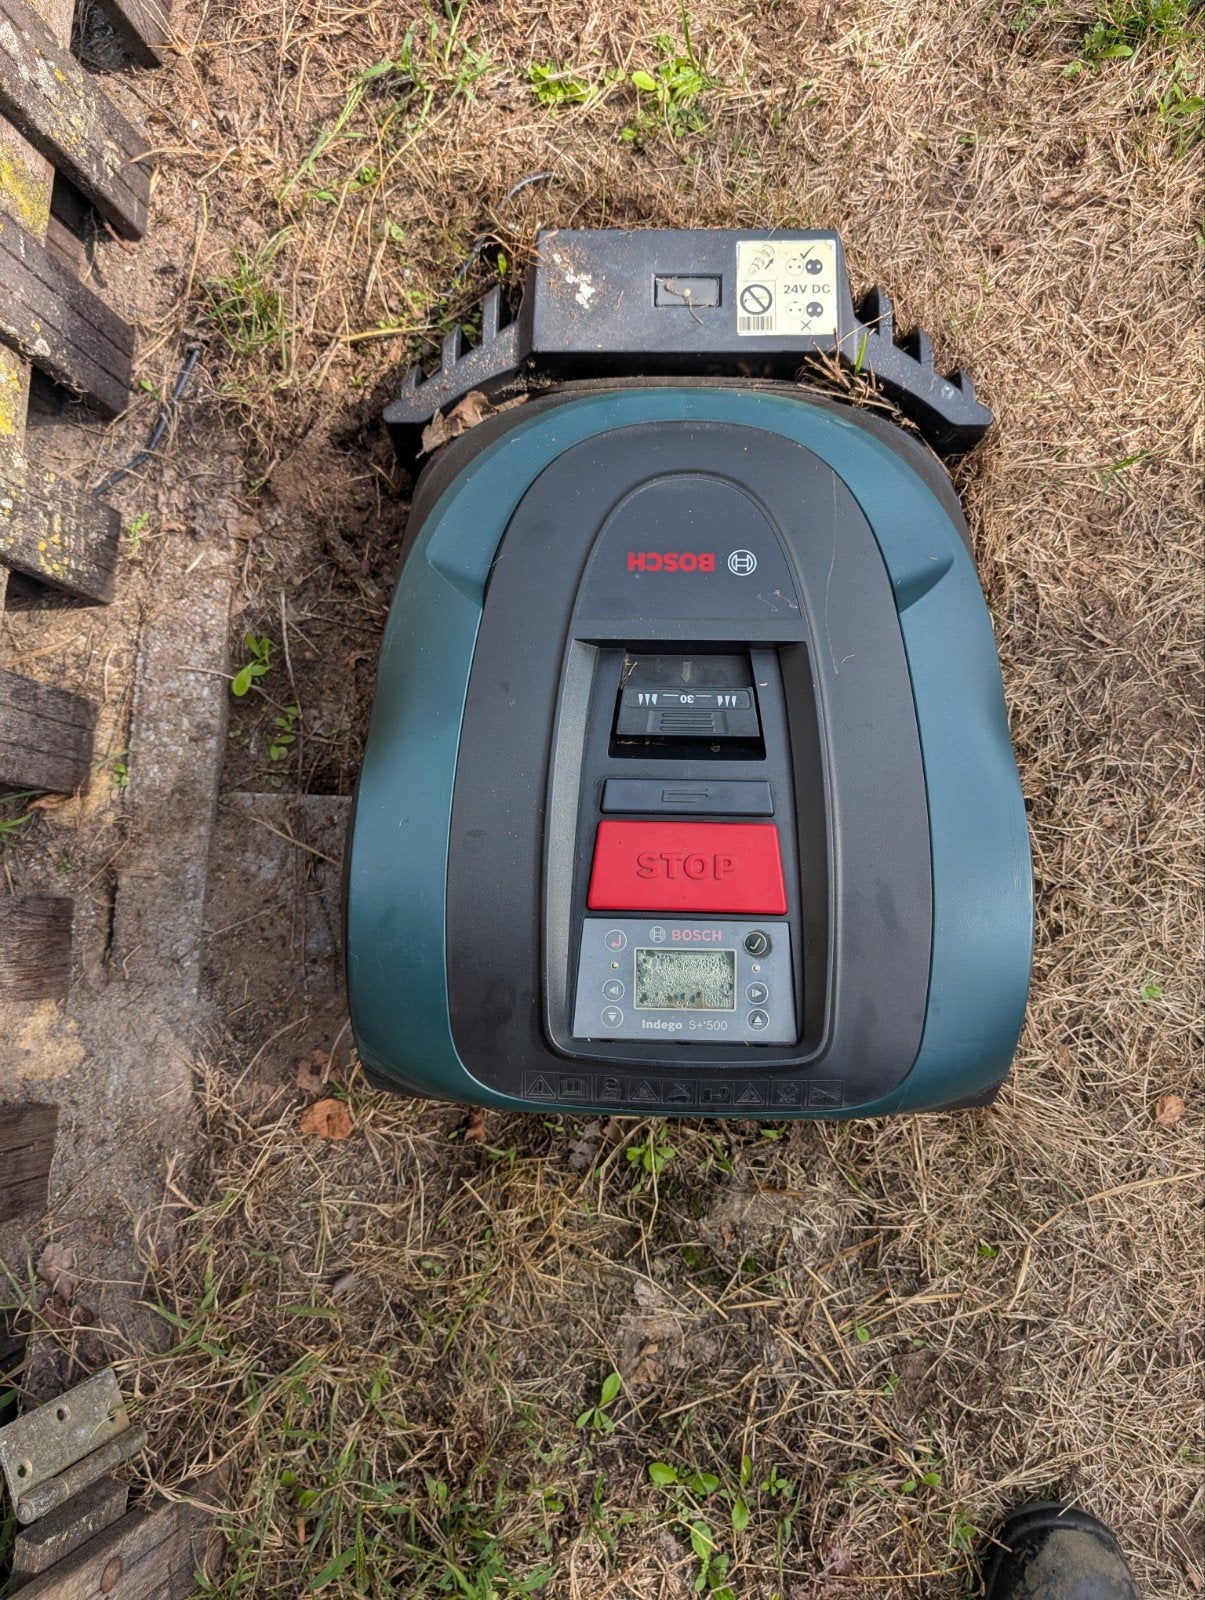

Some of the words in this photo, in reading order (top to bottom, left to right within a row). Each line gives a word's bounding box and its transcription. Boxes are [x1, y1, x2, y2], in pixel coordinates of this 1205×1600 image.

[783, 284, 808, 294] 24V
[812, 284, 831, 294] DC
[628, 552, 715, 572] BOSCH
[680, 694, 695, 704] 30
[636, 852, 738, 880] STOP
[671, 929, 723, 942] BOSCH
[641, 1019, 683, 1032] Indego
